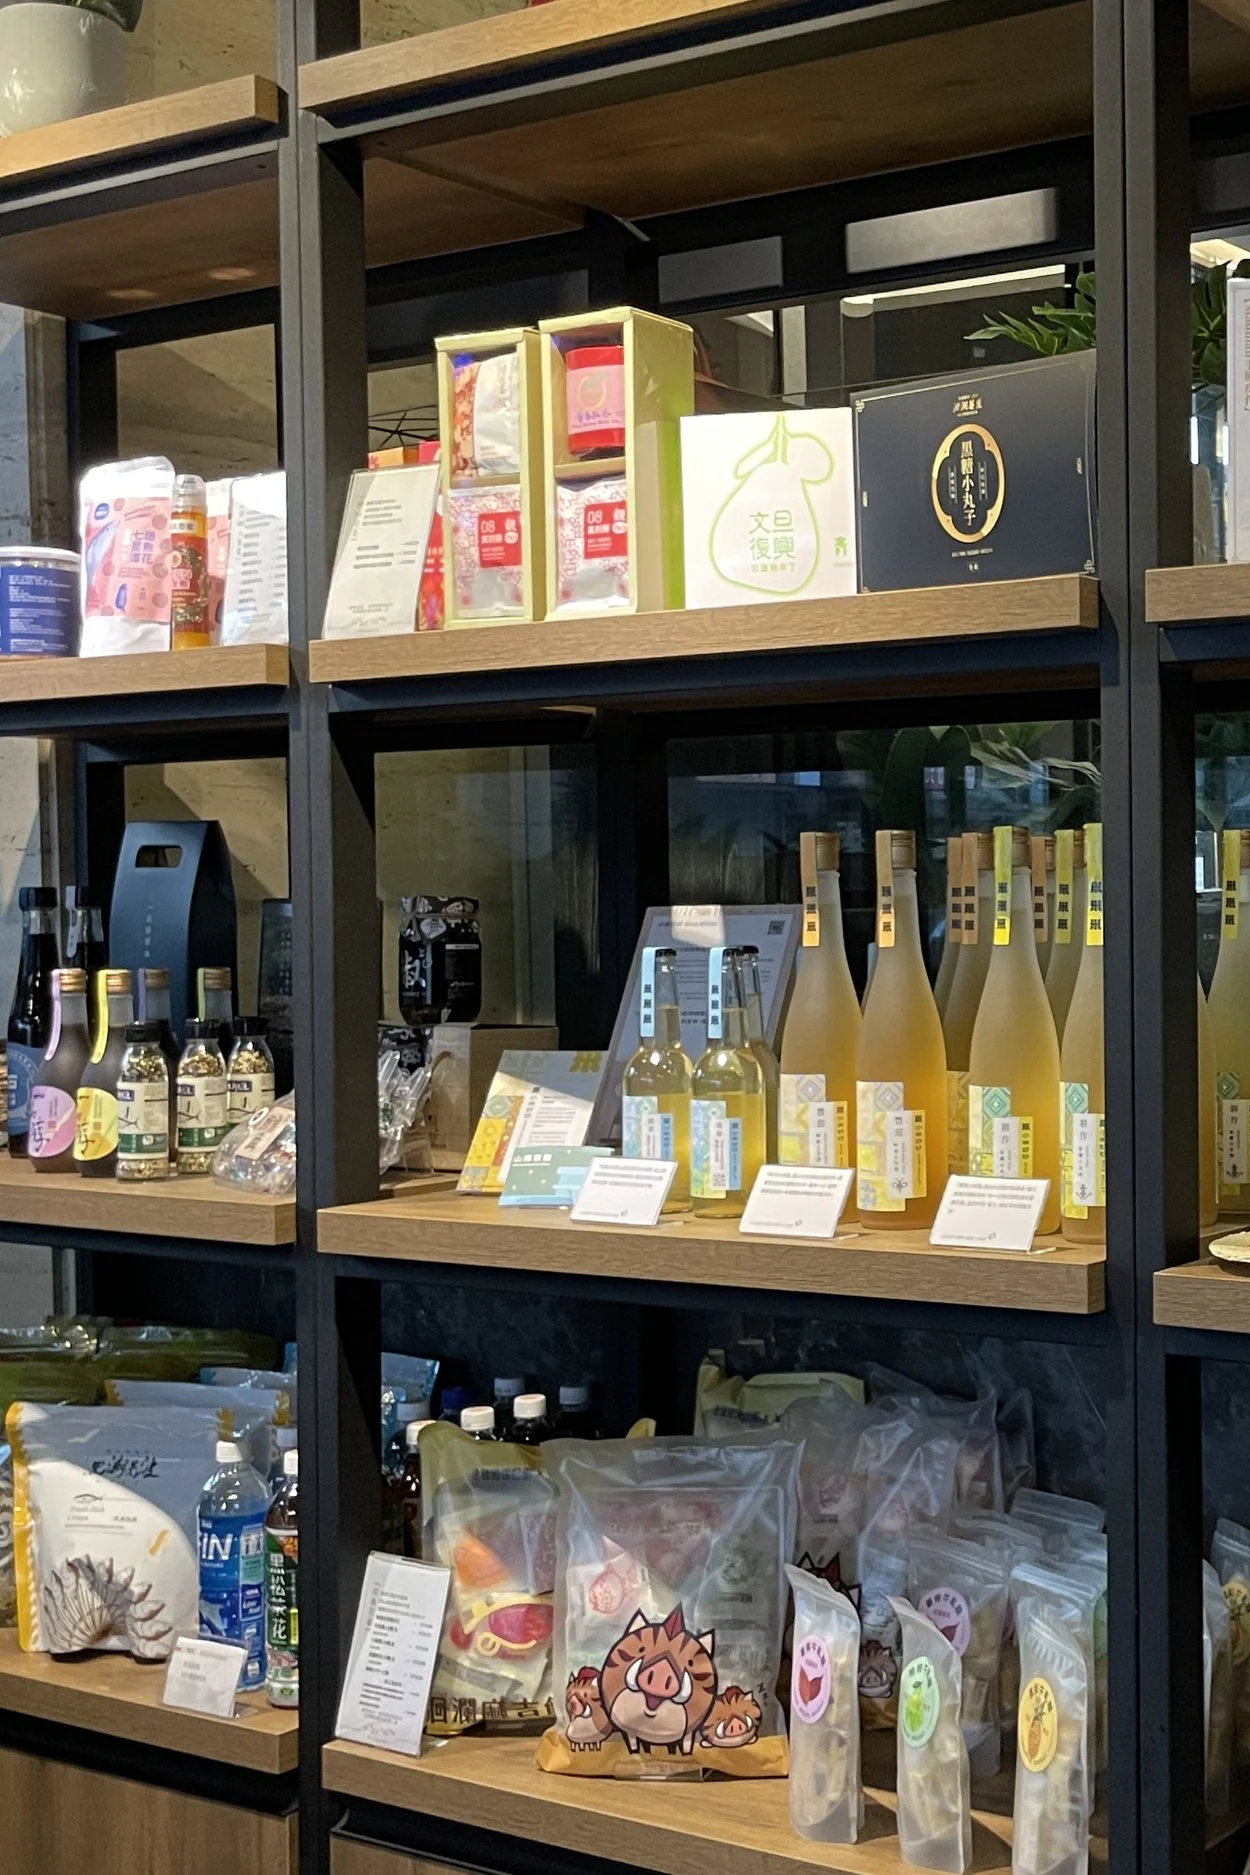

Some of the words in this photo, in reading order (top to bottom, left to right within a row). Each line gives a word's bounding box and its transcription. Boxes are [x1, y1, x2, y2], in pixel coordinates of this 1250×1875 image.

[960, 440, 976, 526] 黑糖小丸子
[748, 510, 794, 534] 文旦
[748, 536, 796, 560] 復興
[202, 1533, 234, 1561] IN
